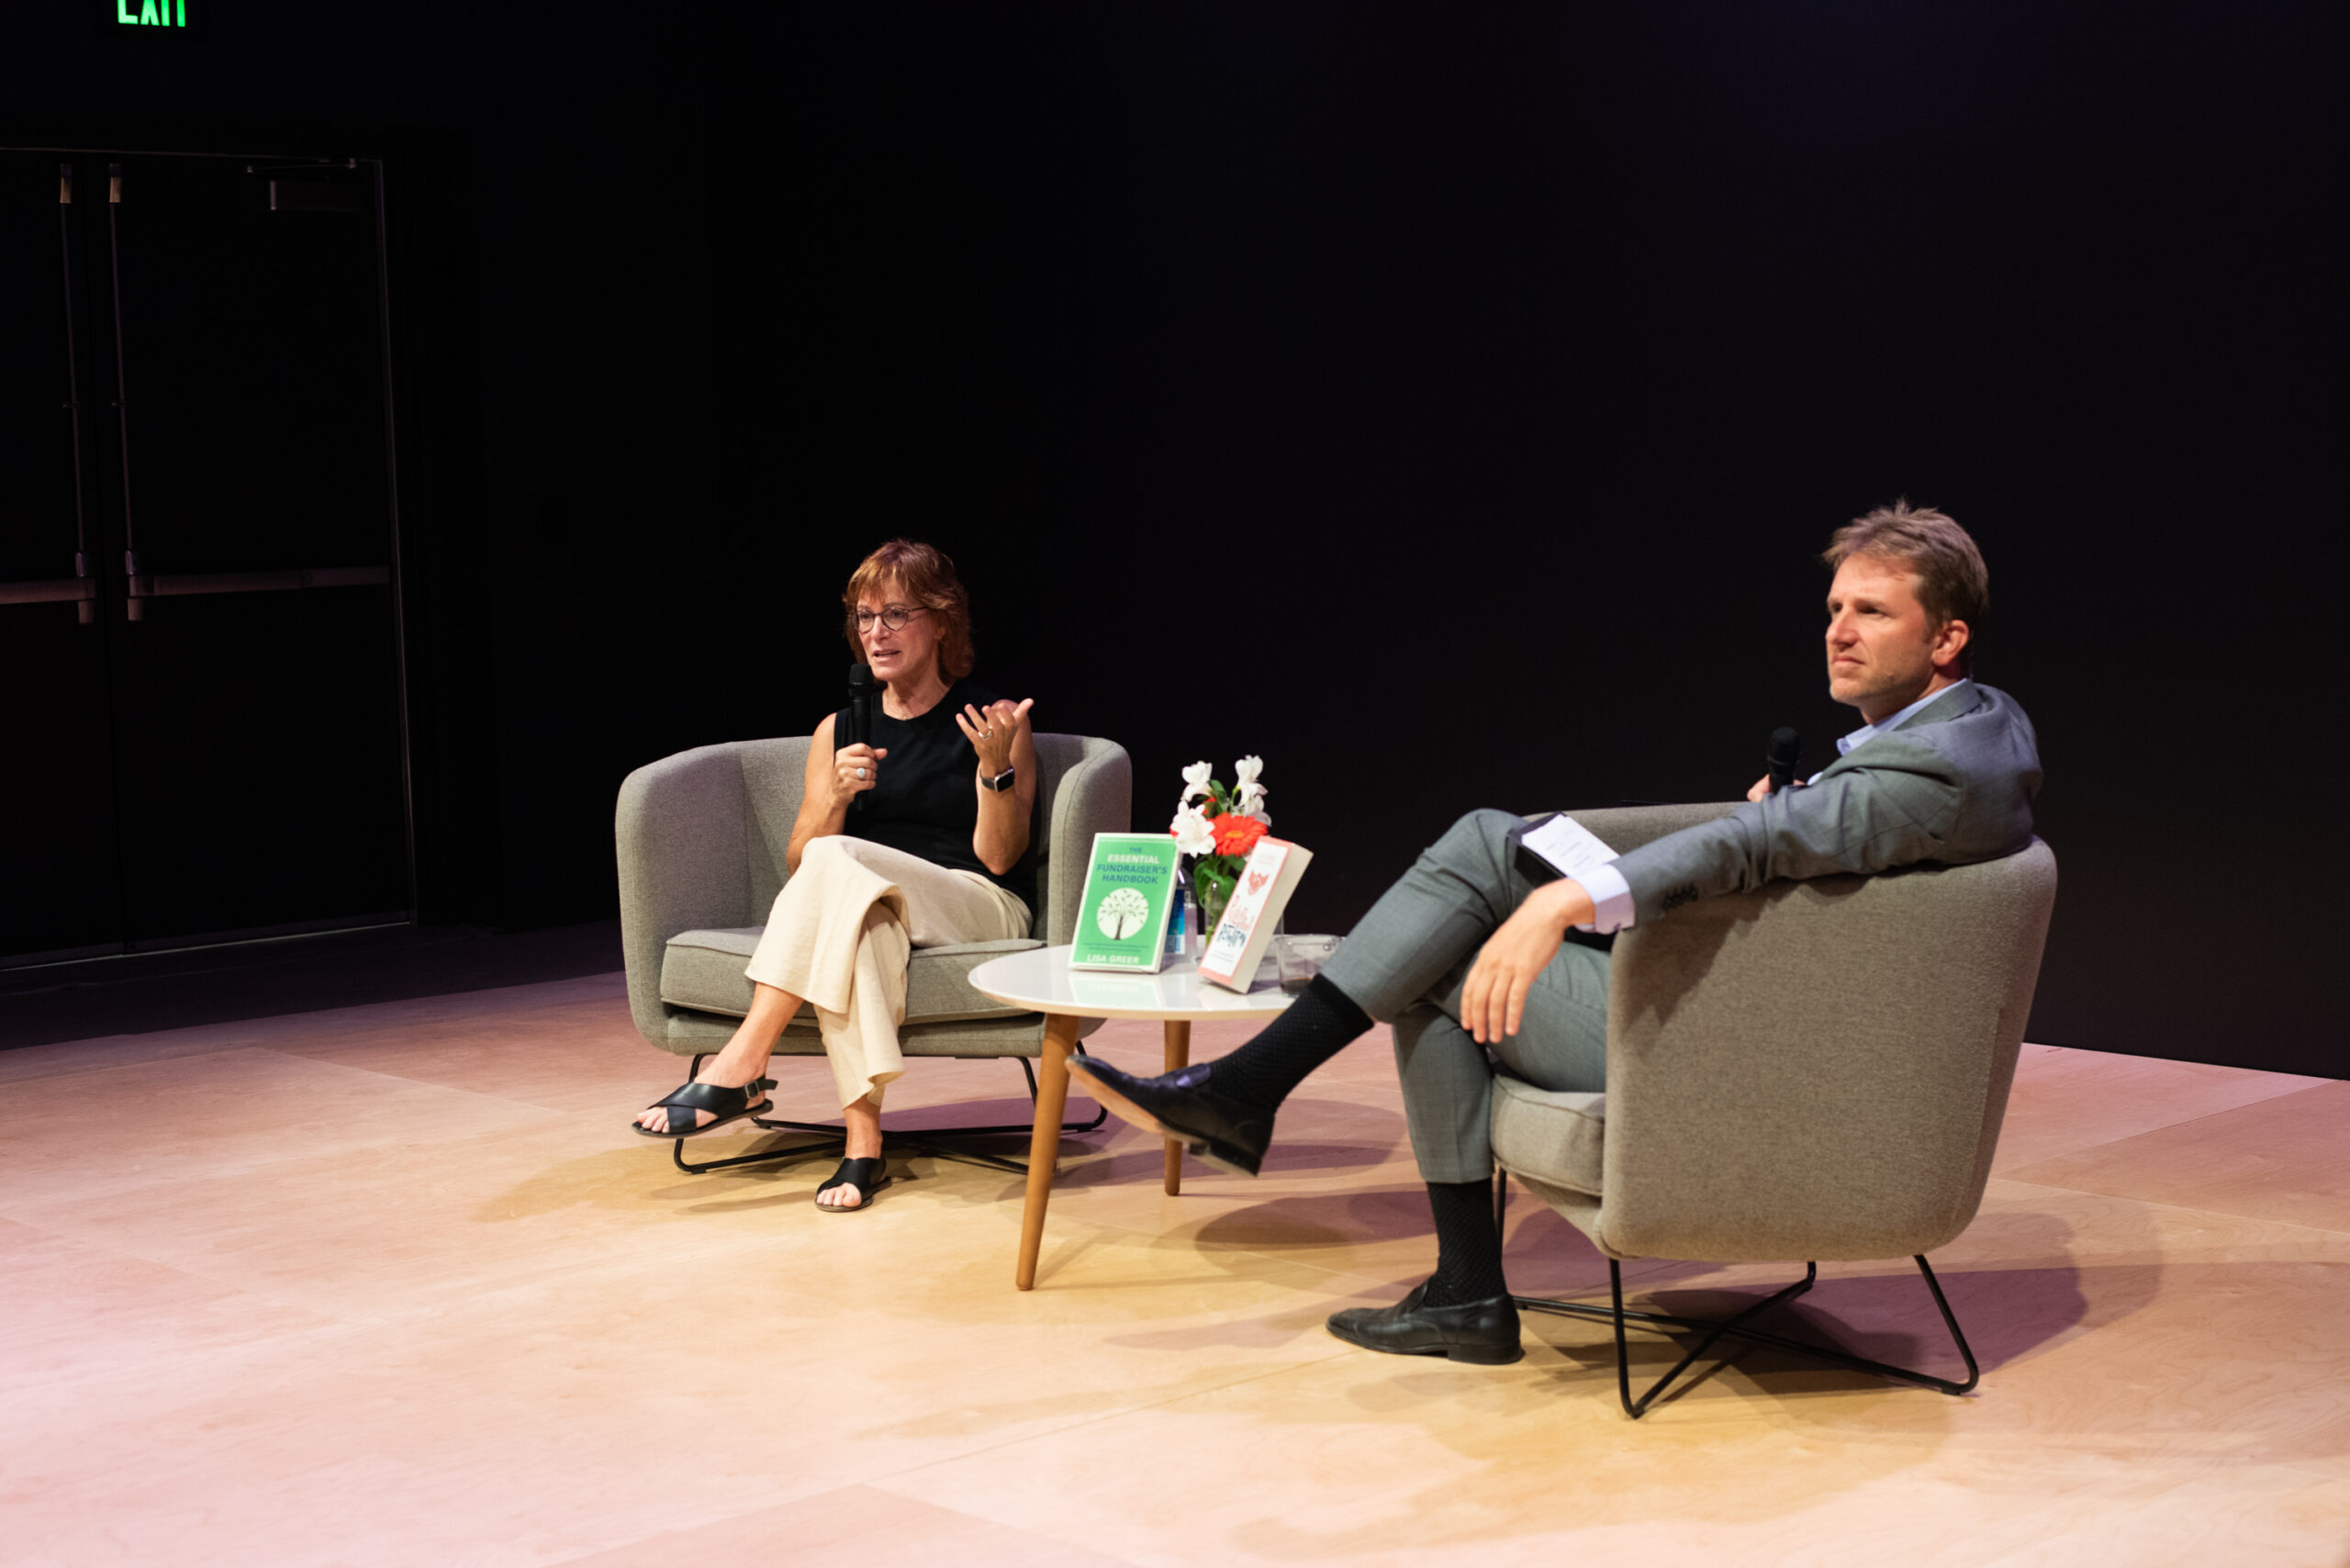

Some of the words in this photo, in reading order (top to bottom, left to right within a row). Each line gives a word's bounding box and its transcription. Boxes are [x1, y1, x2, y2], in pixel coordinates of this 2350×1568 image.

[1107, 854, 1160, 865] ESSENTIAL
[1097, 864, 1168, 875] FUNDRAISER'S
[1102, 873, 1158, 884] HANDBOOK
[1087, 954, 1106, 962] LISA
[1109, 955, 1139, 964] GREER
